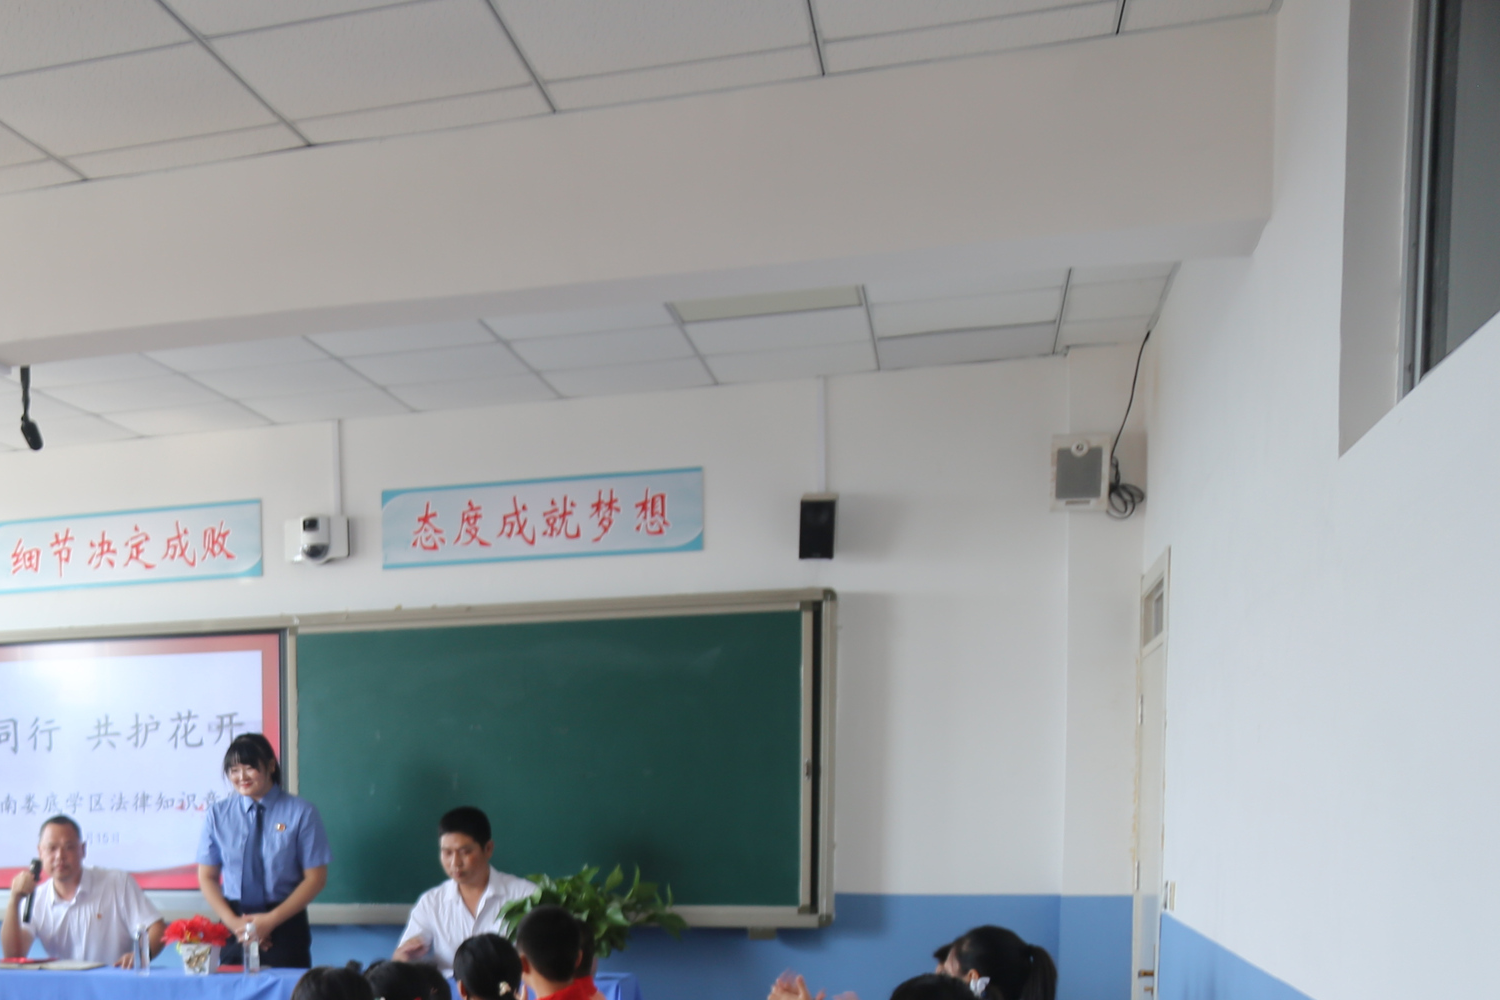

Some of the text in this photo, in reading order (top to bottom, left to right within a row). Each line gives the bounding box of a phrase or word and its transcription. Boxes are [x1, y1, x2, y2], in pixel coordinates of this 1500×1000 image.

[411, 486, 671, 551] 态度成就梦想
[10, 519, 237, 578] 细节决定成败
[87, 710, 245, 751] 共护花开
